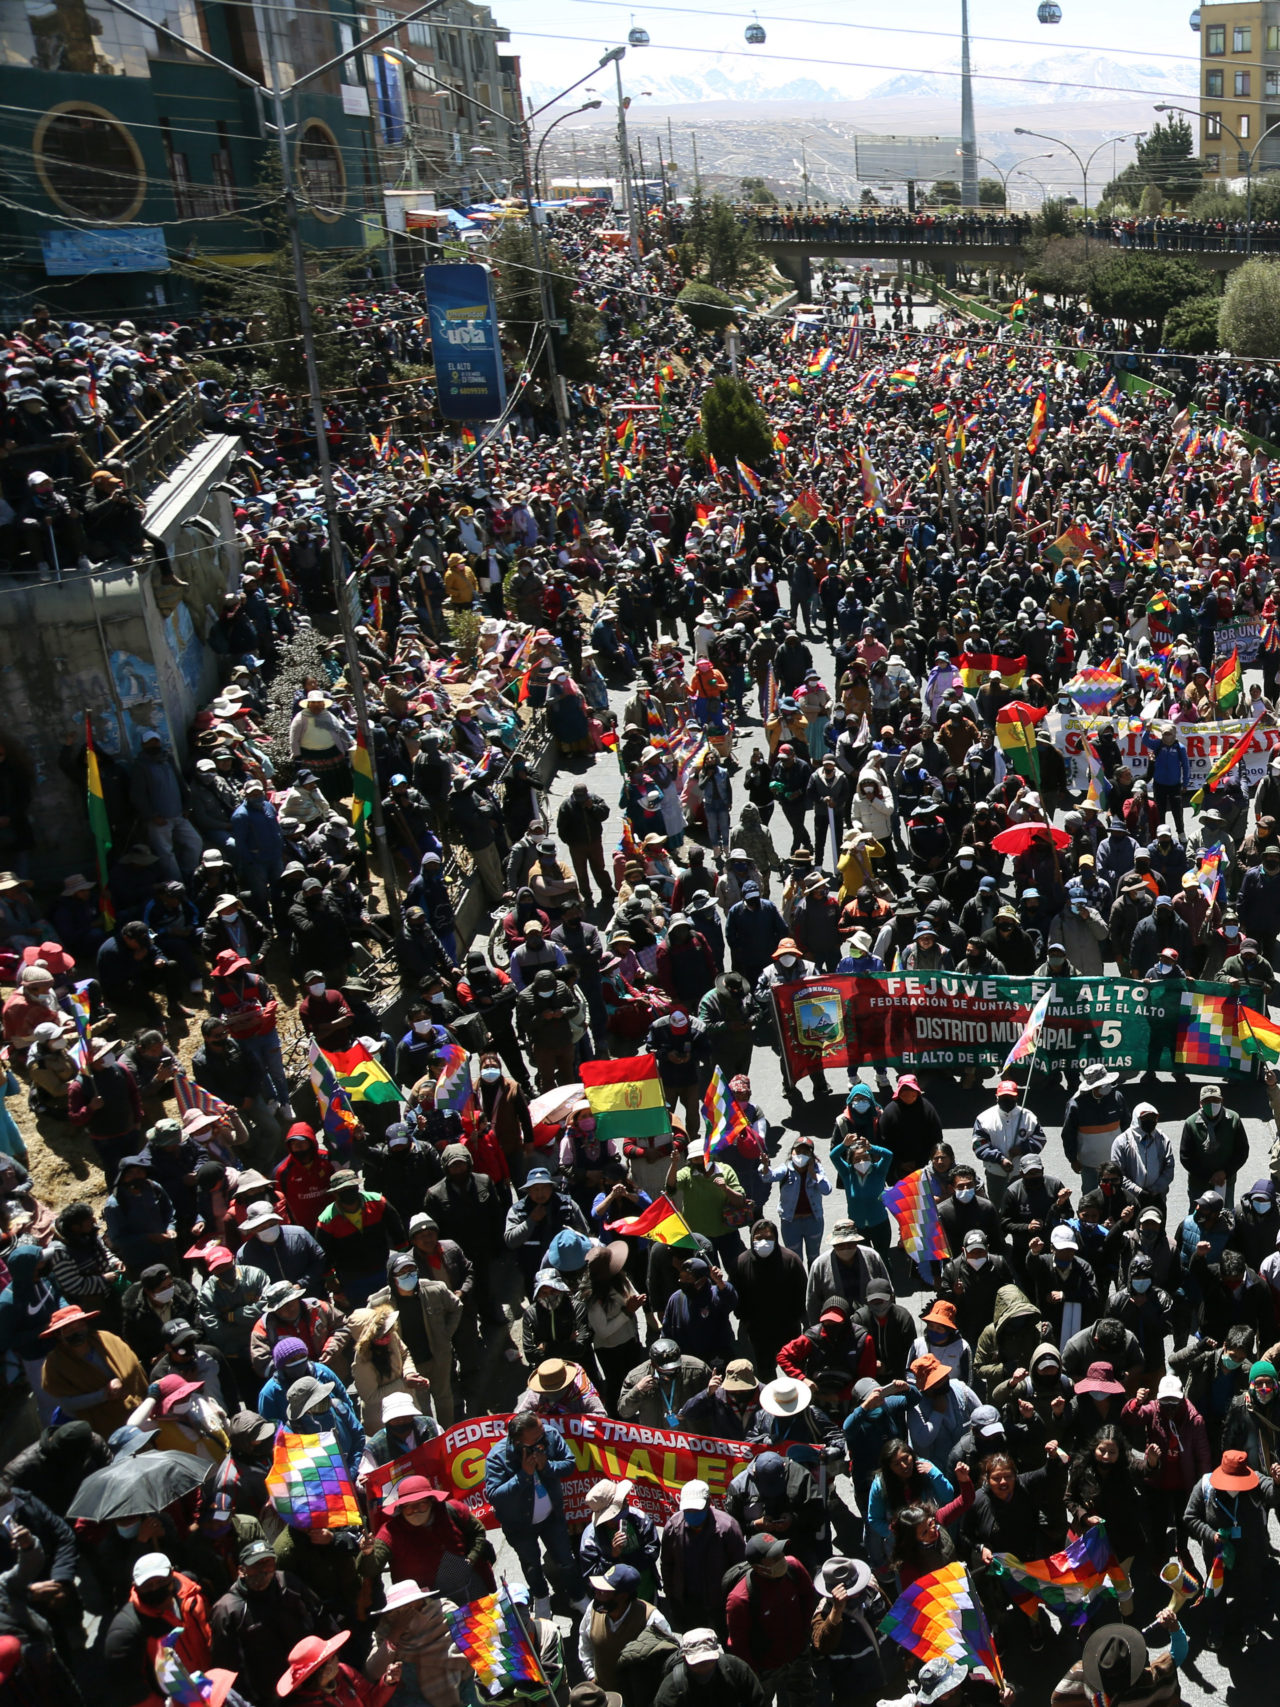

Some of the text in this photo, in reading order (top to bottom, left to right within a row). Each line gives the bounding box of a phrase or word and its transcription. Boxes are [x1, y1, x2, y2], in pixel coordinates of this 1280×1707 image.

[1214, 628, 1238, 643] POR
[887, 977, 998, 1000] FEJUVE
[1031, 982, 1064, 1003] EL
[1076, 984, 1149, 1002] ALTO
[869, 996, 1165, 1018] FEDERACIÓN DE JUNTAS VINALES DE EL ALTO
[915, 1017, 988, 1043] DISTRITO
[991, 1021, 1076, 1050] MUNCIPAL
[1099, 1020, 1122, 1048] 5
[902, 1052, 918, 1064] EL
[921, 1052, 954, 1064] ALTO
[958, 1053, 974, 1064] DE
[979, 1053, 1003, 1065] PIE,
[1051, 1059, 1066, 1071] DE
[569, 1418, 596, 1439] DE
[601, 1422, 754, 1460] TRABAJADORES
